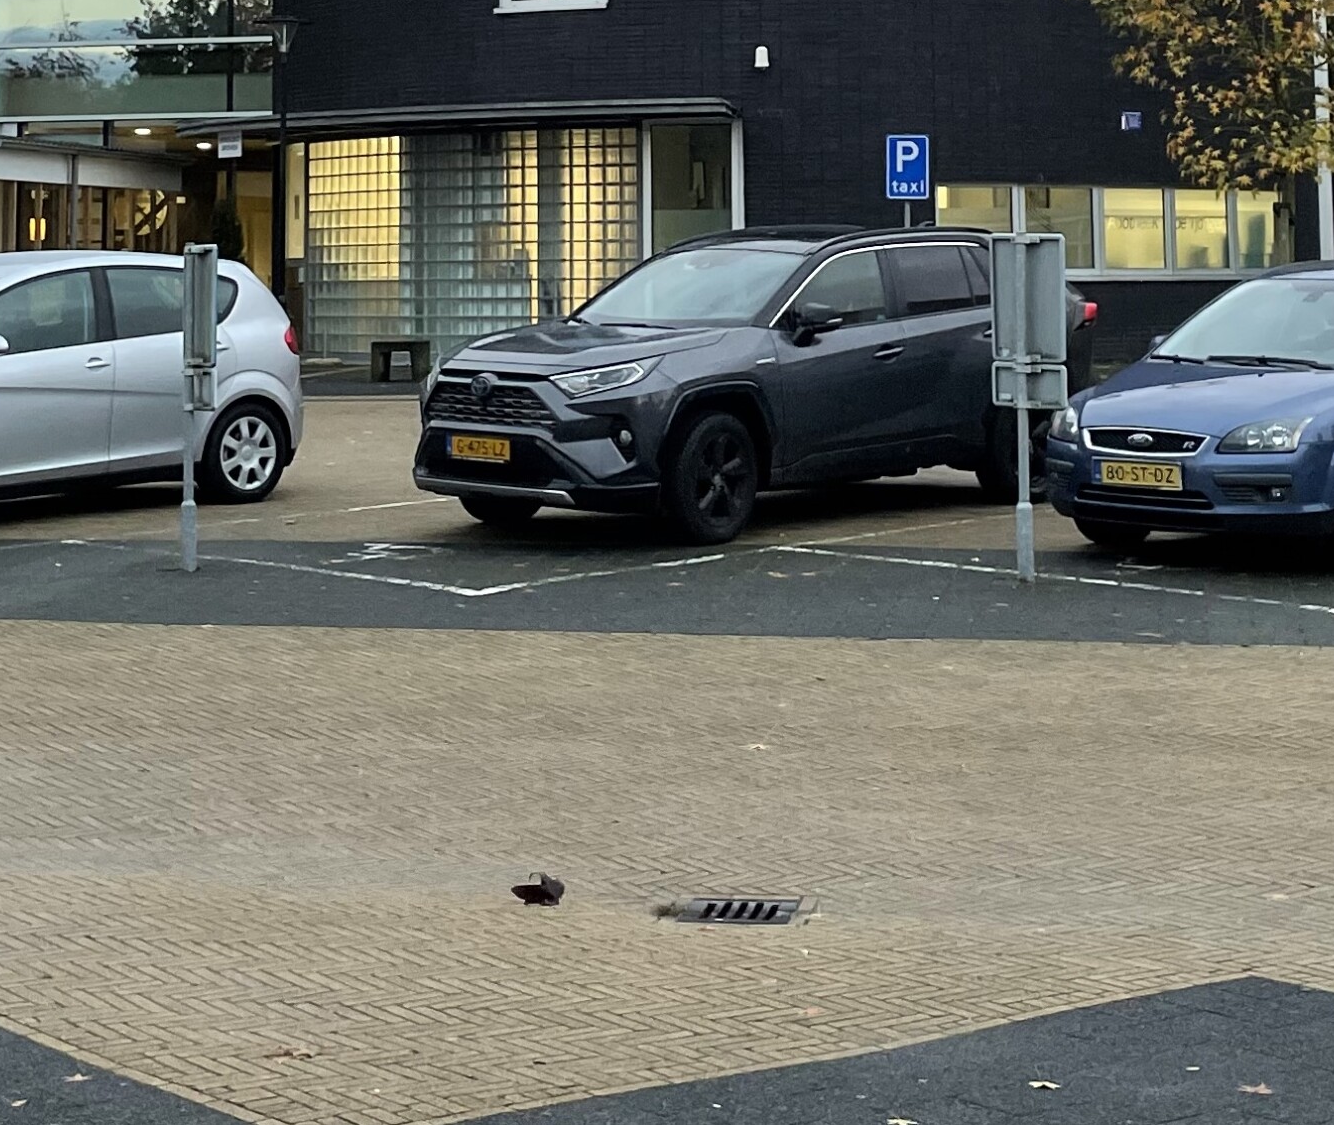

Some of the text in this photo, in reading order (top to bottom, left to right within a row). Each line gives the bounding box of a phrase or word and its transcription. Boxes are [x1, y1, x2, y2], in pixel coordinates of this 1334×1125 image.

[896, 140, 919, 172] P
[892, 180, 924, 193] taxi
[1106, 465, 1175, 484] 80-ST-DZ
